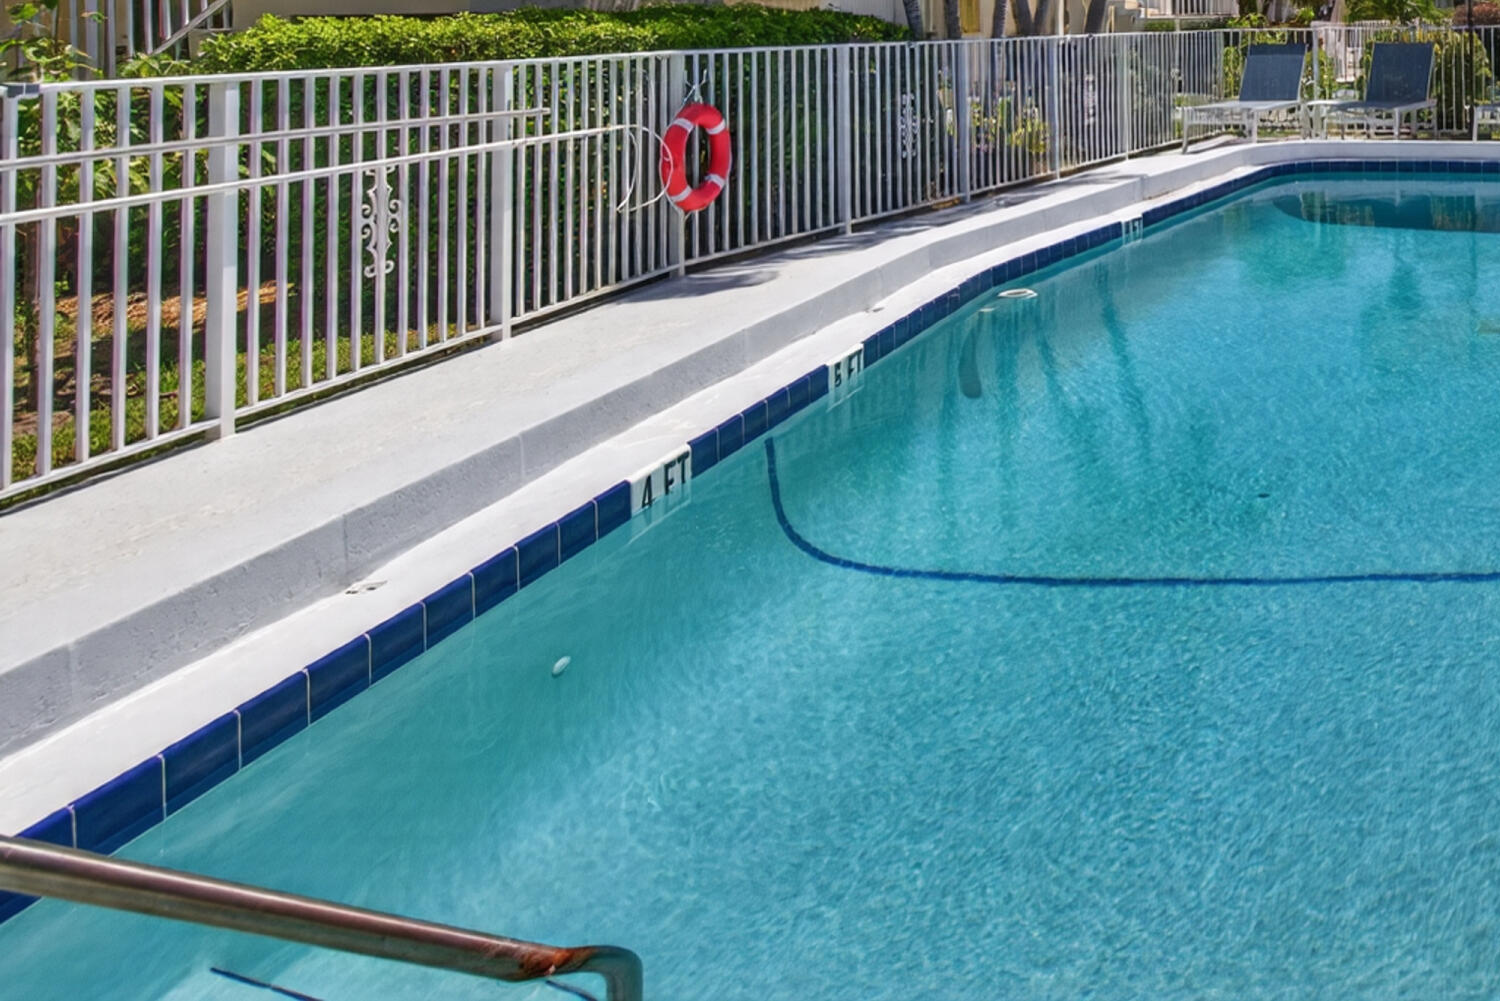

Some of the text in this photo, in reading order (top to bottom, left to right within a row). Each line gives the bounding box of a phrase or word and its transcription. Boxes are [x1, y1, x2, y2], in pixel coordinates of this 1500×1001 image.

[847, 349, 863, 380] FT
[641, 450, 690, 509] 4 FT
